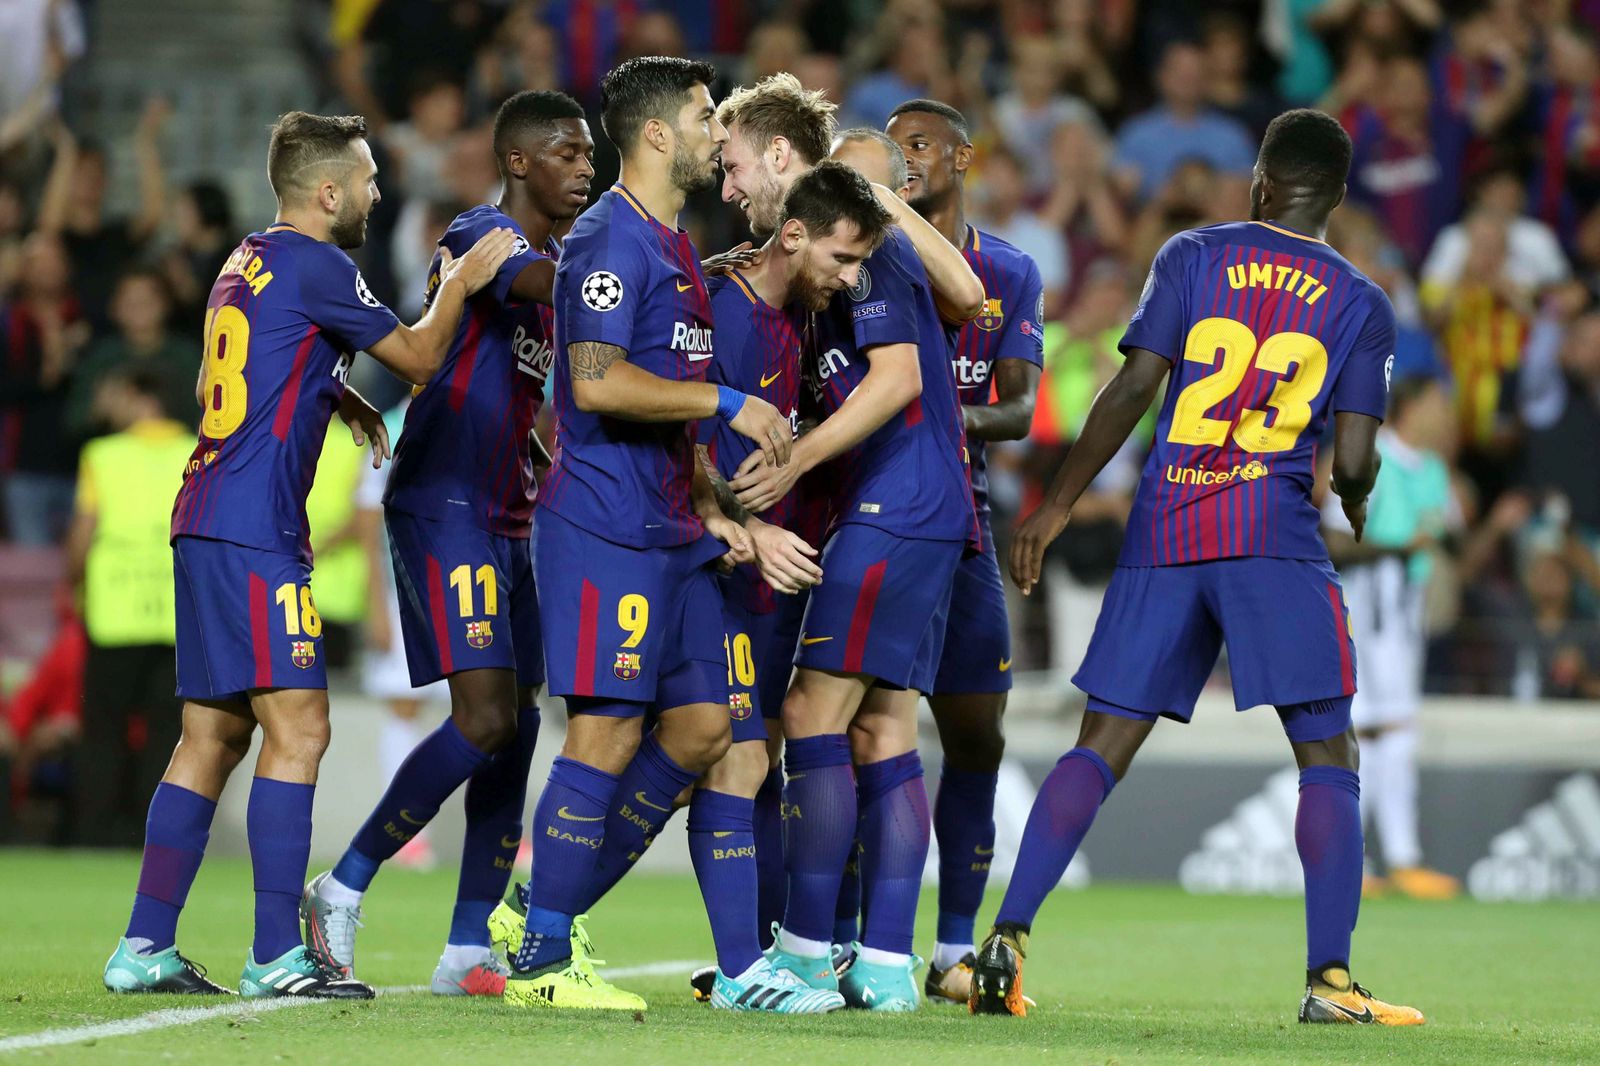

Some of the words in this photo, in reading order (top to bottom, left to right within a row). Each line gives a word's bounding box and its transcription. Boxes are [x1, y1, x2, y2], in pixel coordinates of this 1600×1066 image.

[853, 304, 887, 318] RESPECT
[1226, 262, 1328, 305] UMTITI
[1166, 316, 1329, 454] 23
[1166, 464, 1241, 485] unicef
[275, 582, 322, 638] 18
[449, 563, 498, 618] 11
[617, 593, 650, 648] 9
